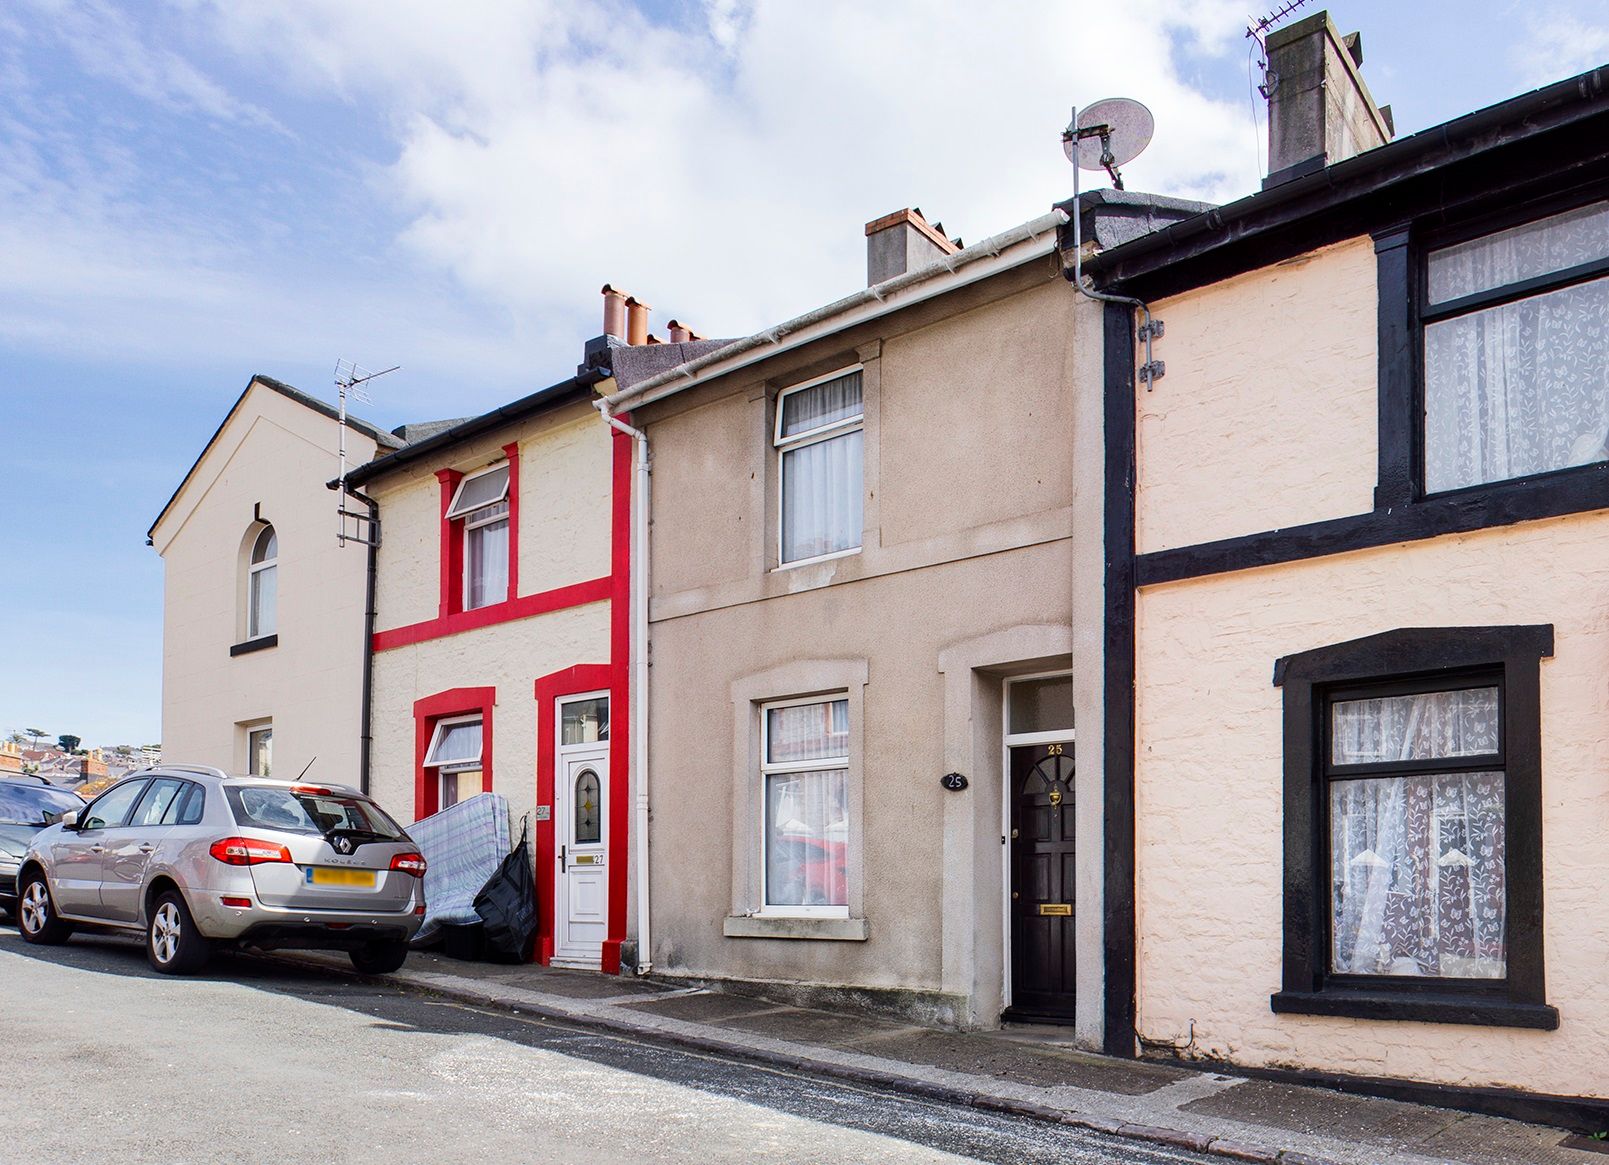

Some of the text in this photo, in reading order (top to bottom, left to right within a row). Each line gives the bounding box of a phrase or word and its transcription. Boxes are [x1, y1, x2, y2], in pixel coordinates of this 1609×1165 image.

[1048, 745, 1062, 755] 25
[949, 775, 961, 787] 25
[537, 807, 546, 815] 27
[595, 855, 603, 864] 27
